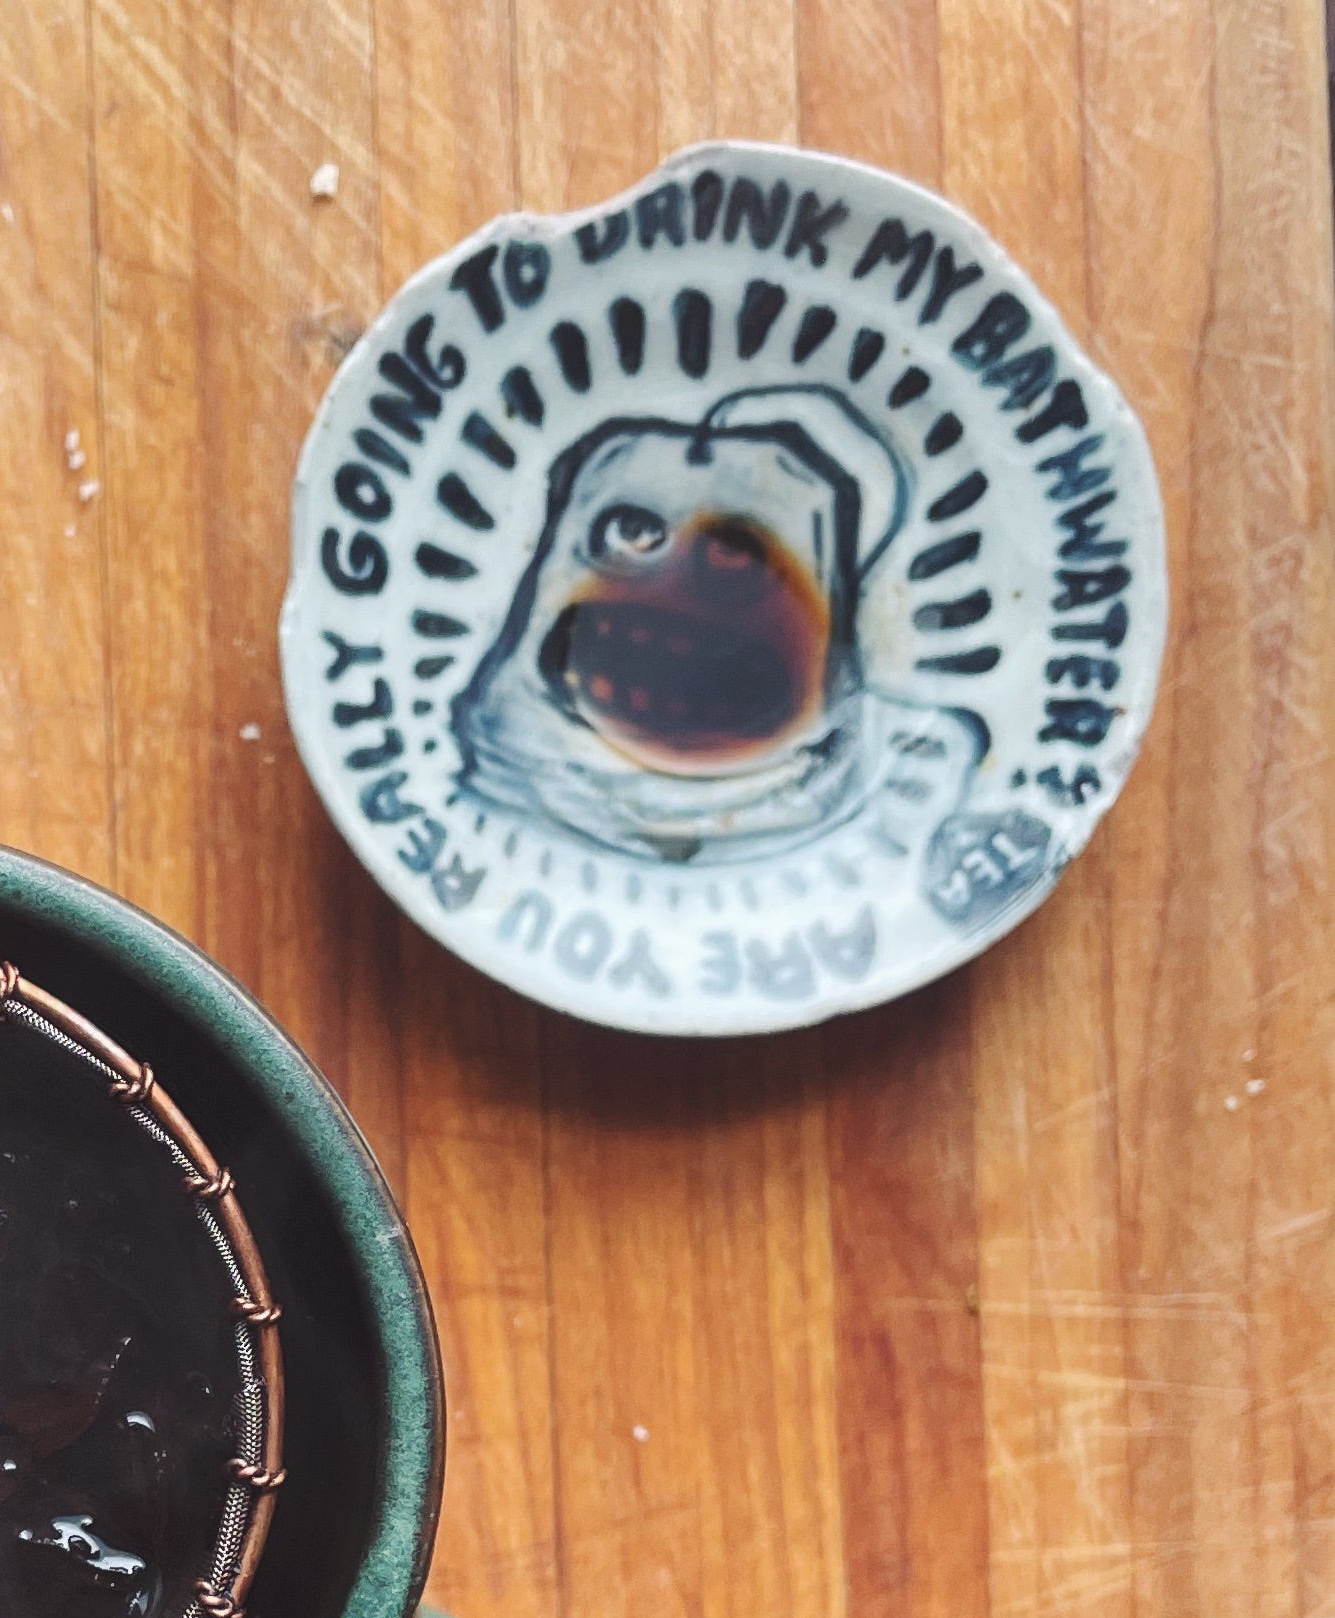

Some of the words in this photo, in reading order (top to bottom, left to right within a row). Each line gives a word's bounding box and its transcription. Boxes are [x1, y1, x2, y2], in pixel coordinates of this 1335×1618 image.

[573, 170, 850, 267] DRINK
[450, 242, 550, 333] TO
[852, 217, 985, 327] MY
[321, 313, 467, 596] GOING
[321, 630, 490, 913] REALLY
[928, 825, 1050, 910] TEA
[497, 892, 676, 998] YOU
[698, 904, 879, 1001] ARE
